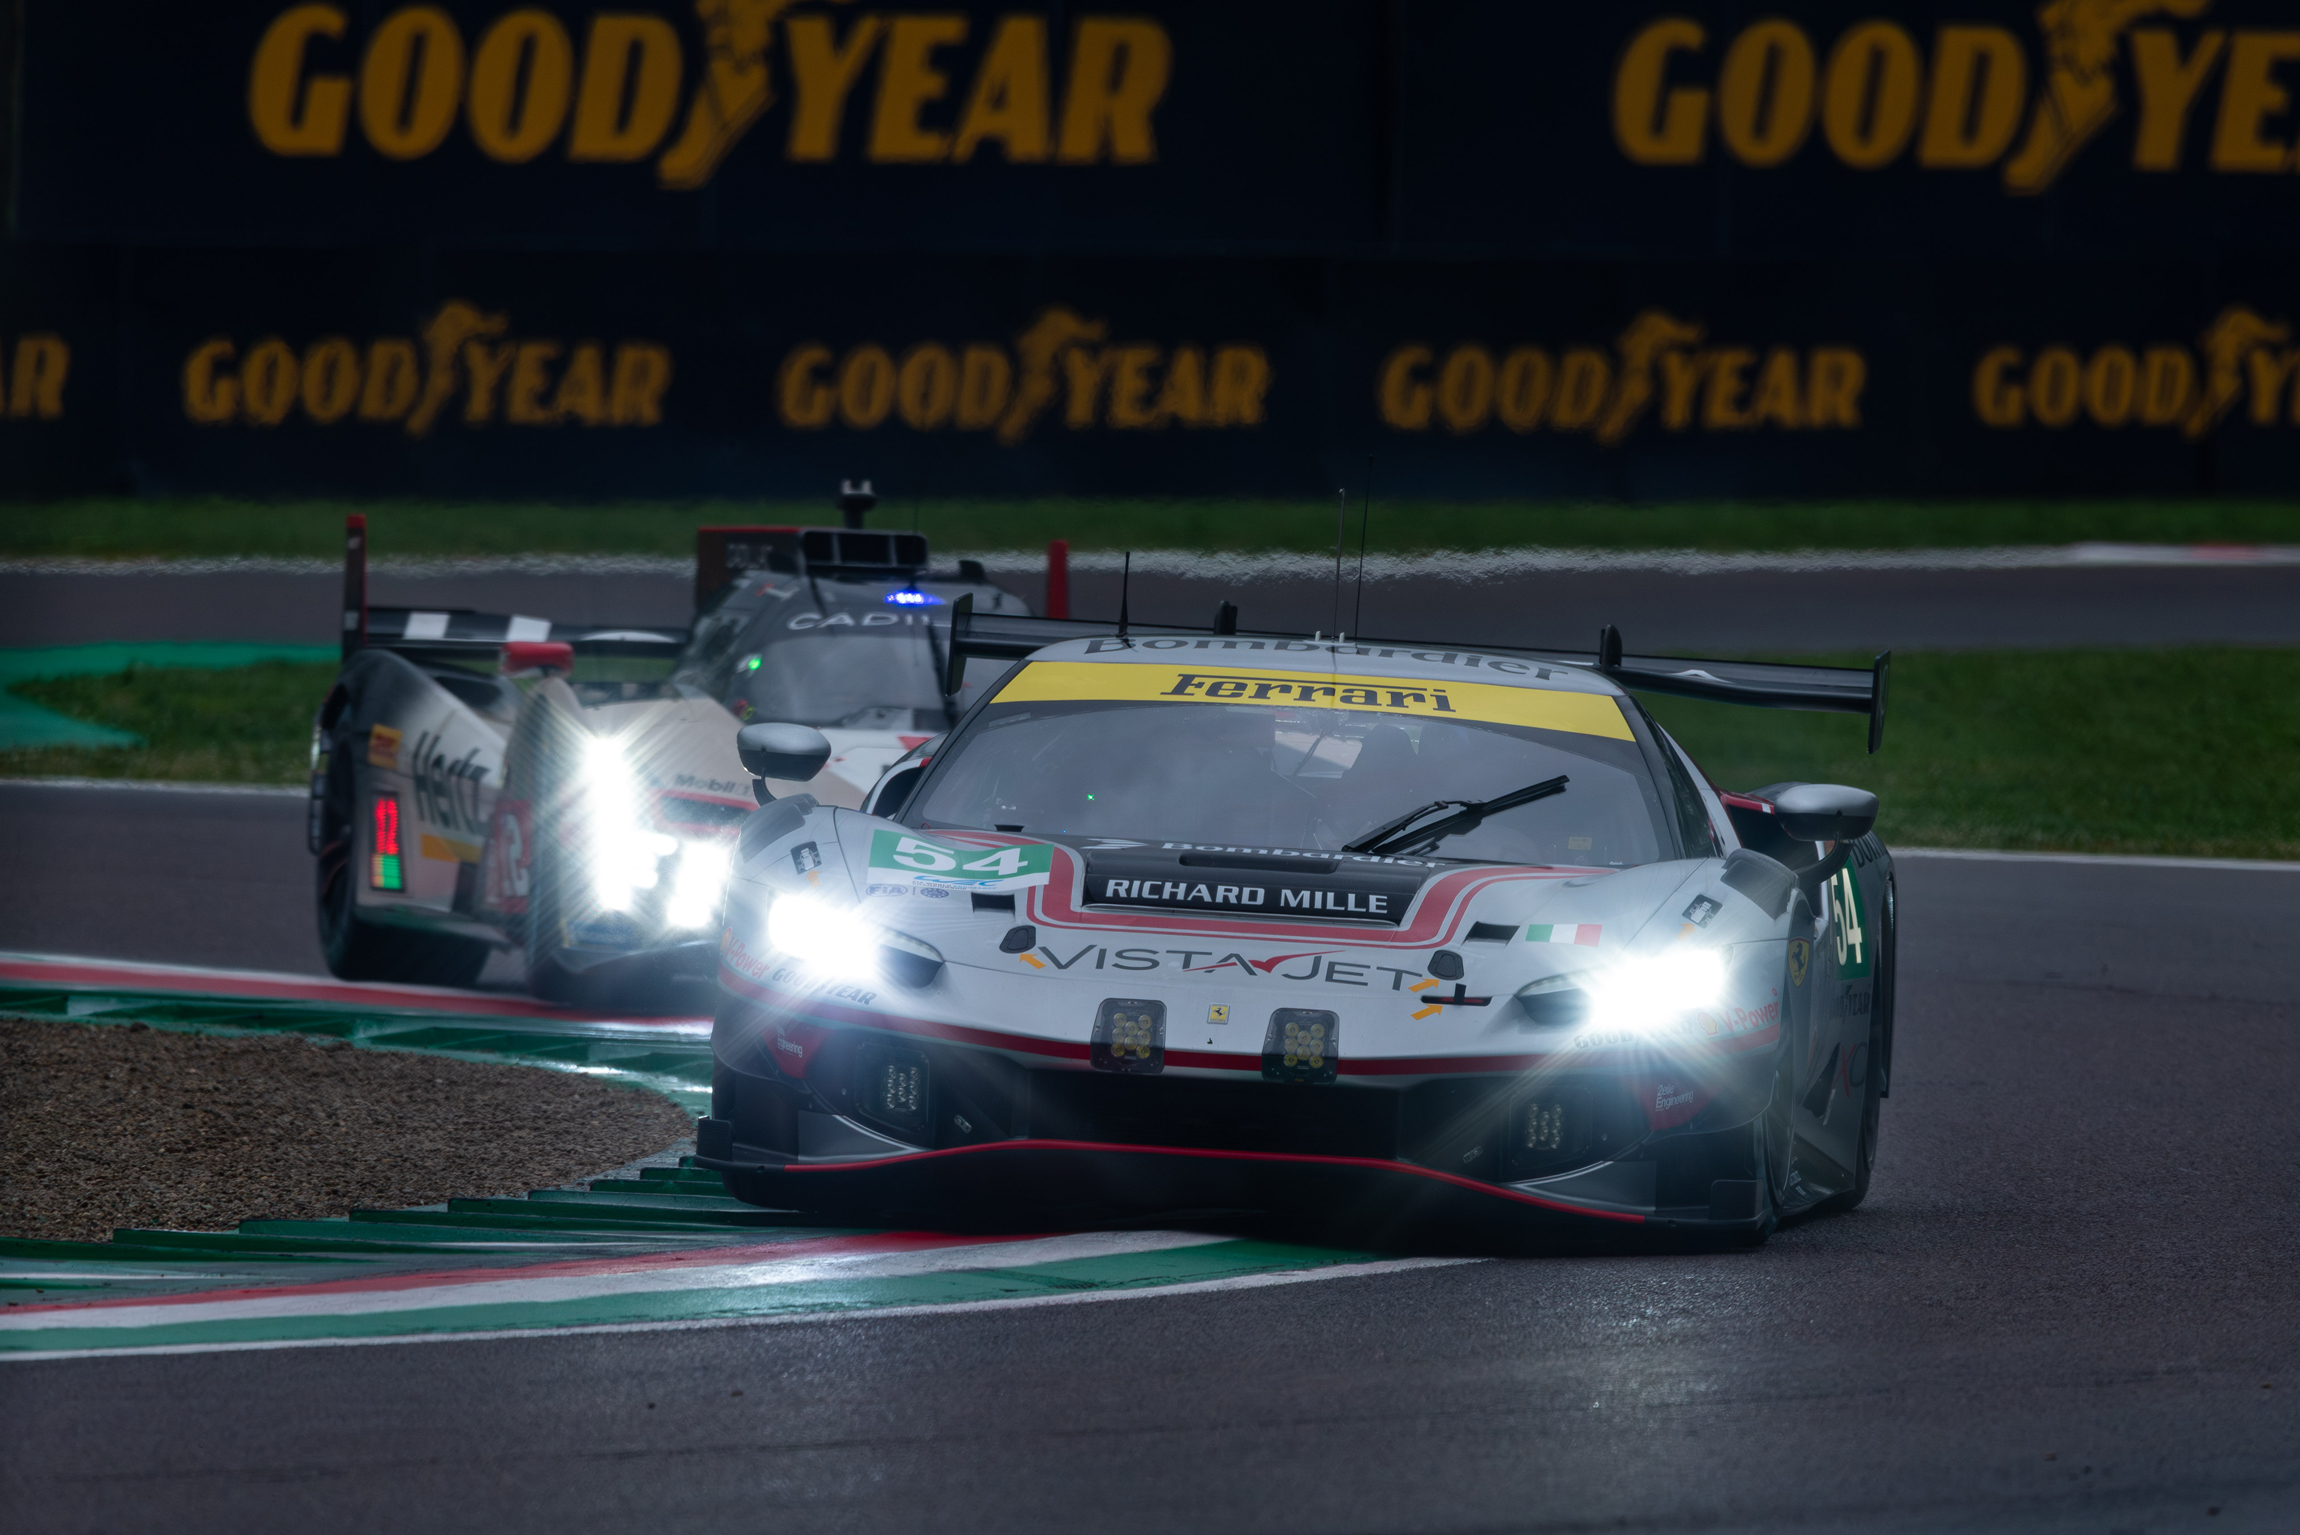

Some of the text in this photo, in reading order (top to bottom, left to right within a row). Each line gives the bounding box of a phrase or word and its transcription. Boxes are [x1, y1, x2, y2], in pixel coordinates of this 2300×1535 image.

[247, 4, 1173, 164] GOODYEAR
[1612, 17, 2300, 172] GOODYE
[184, 336, 672, 426] GOODYEAR
[779, 341, 1271, 430] GOODYEAR
[1380, 344, 1867, 431] GOODYEAR
[1972, 340, 2300, 431] GOODY
[1084, 636, 1569, 682] Bombardier
[1160, 673, 1456, 713] Ferrari
[893, 836, 1028, 877] 54
[1105, 878, 1389, 915] RICHARD MILLE
[1161, 842, 1446, 869] Bombardier
[1830, 867, 1863, 967] 54
[1716, 1000, 1781, 1034] V-Power
